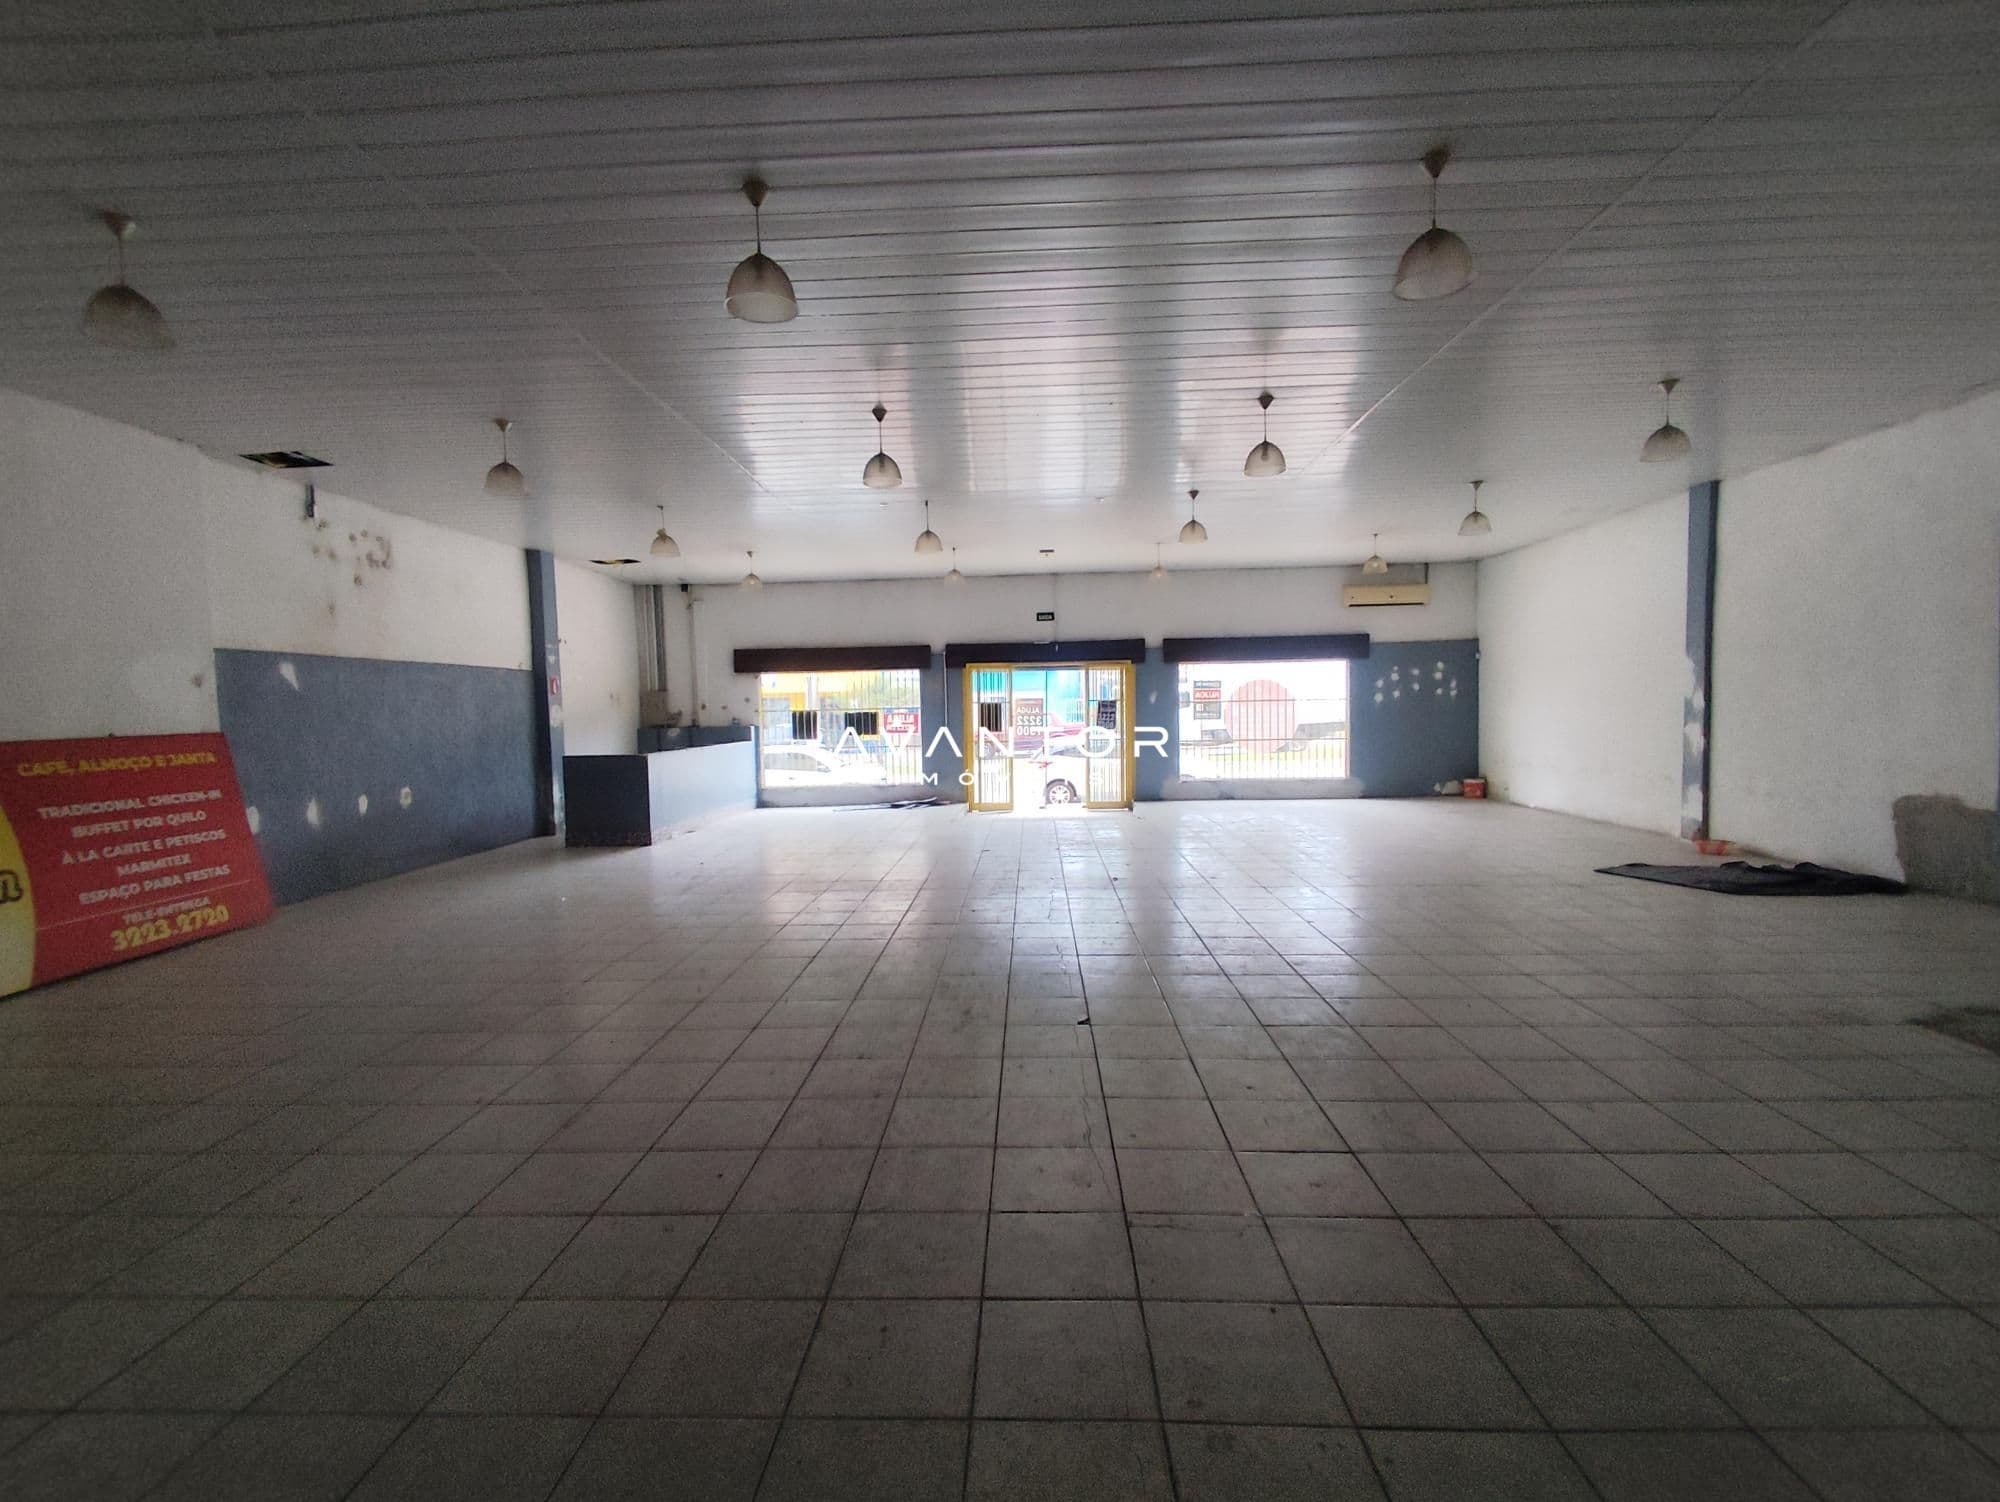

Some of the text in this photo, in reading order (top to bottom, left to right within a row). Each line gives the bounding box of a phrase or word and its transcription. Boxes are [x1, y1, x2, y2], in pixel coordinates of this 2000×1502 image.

[154, 755, 167, 768] E
[169, 752, 218, 767] JANTA
[38, 798, 145, 820] TRADICIONAL
[71, 810, 207, 838] BUFFET POR QUILO
[77, 850, 98, 863] LA
[102, 843, 151, 859] CARTE
[154, 839, 164, 850] E
[166, 829, 227, 848] PETISCOS
[117, 853, 193, 877] MARMITEX
[79, 864, 232, 905] ESPAÇO PARA FESTAS
[110, 904, 230, 951] 3223.2720
